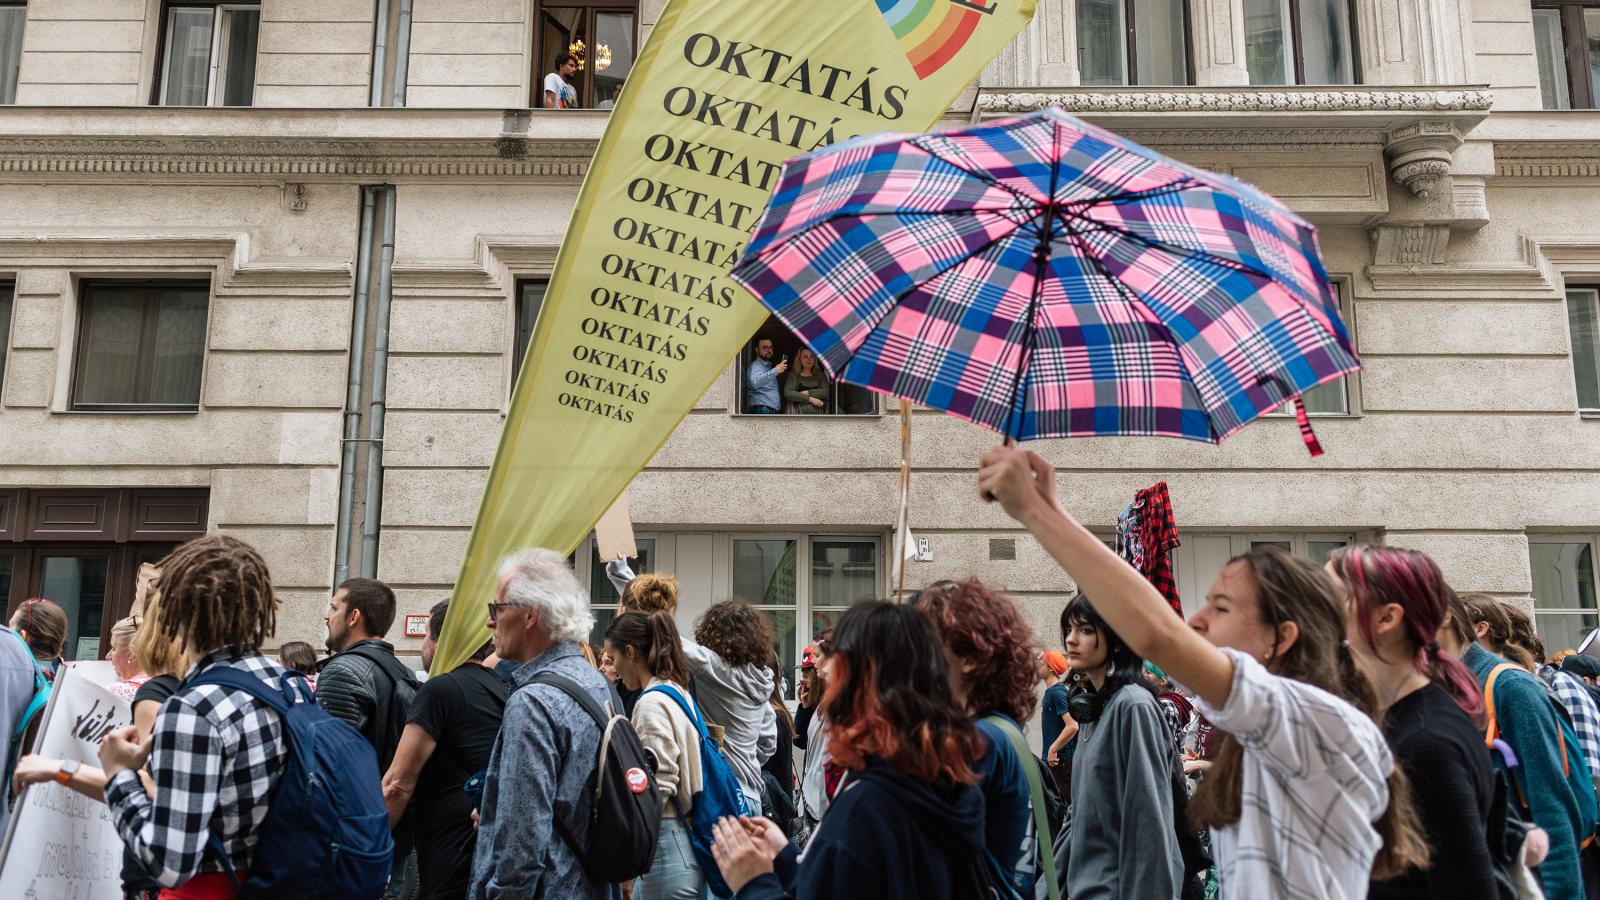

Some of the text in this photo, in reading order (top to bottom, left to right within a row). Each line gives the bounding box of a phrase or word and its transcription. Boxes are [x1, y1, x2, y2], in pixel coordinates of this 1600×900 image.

[683, 32, 908, 120] OKTATÁS
[663, 86, 859, 152] OKTATÁ
[644, 134, 782, 191] OKTAT
[627, 177, 770, 234] OKTAT
[613, 217, 742, 270] OKTATÁ
[601, 254, 735, 309] OKTATÁS
[590, 287, 710, 336] OKTATÁS
[572, 345, 668, 384] OKTATÁS
[581, 317, 688, 361] OKTATÁS
[558, 392, 634, 424] OKTATÁS
[565, 370, 650, 405] OKTATÁS
